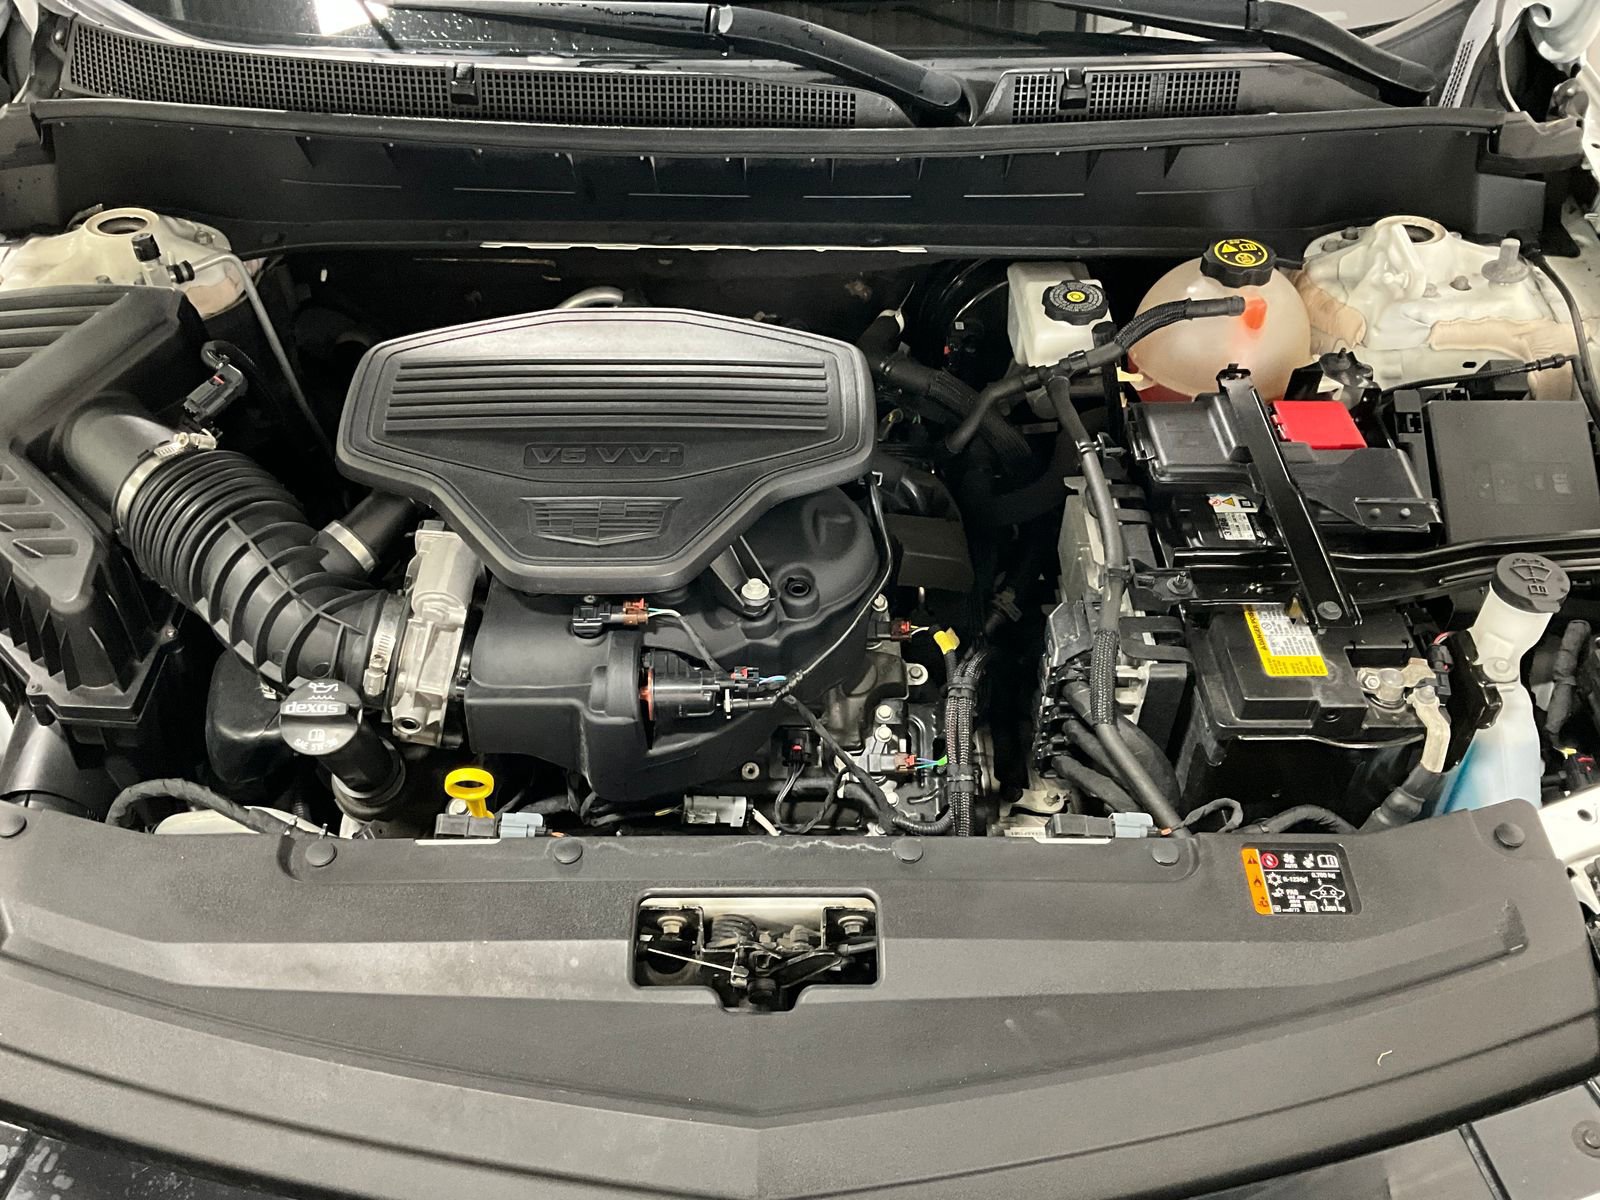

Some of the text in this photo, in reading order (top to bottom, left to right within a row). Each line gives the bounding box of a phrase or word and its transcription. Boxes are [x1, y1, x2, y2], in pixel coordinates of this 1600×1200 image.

[531, 447, 680, 463] V6 VVT
[285, 701, 340, 713] dexos
[295, 738, 309, 750] SAE
